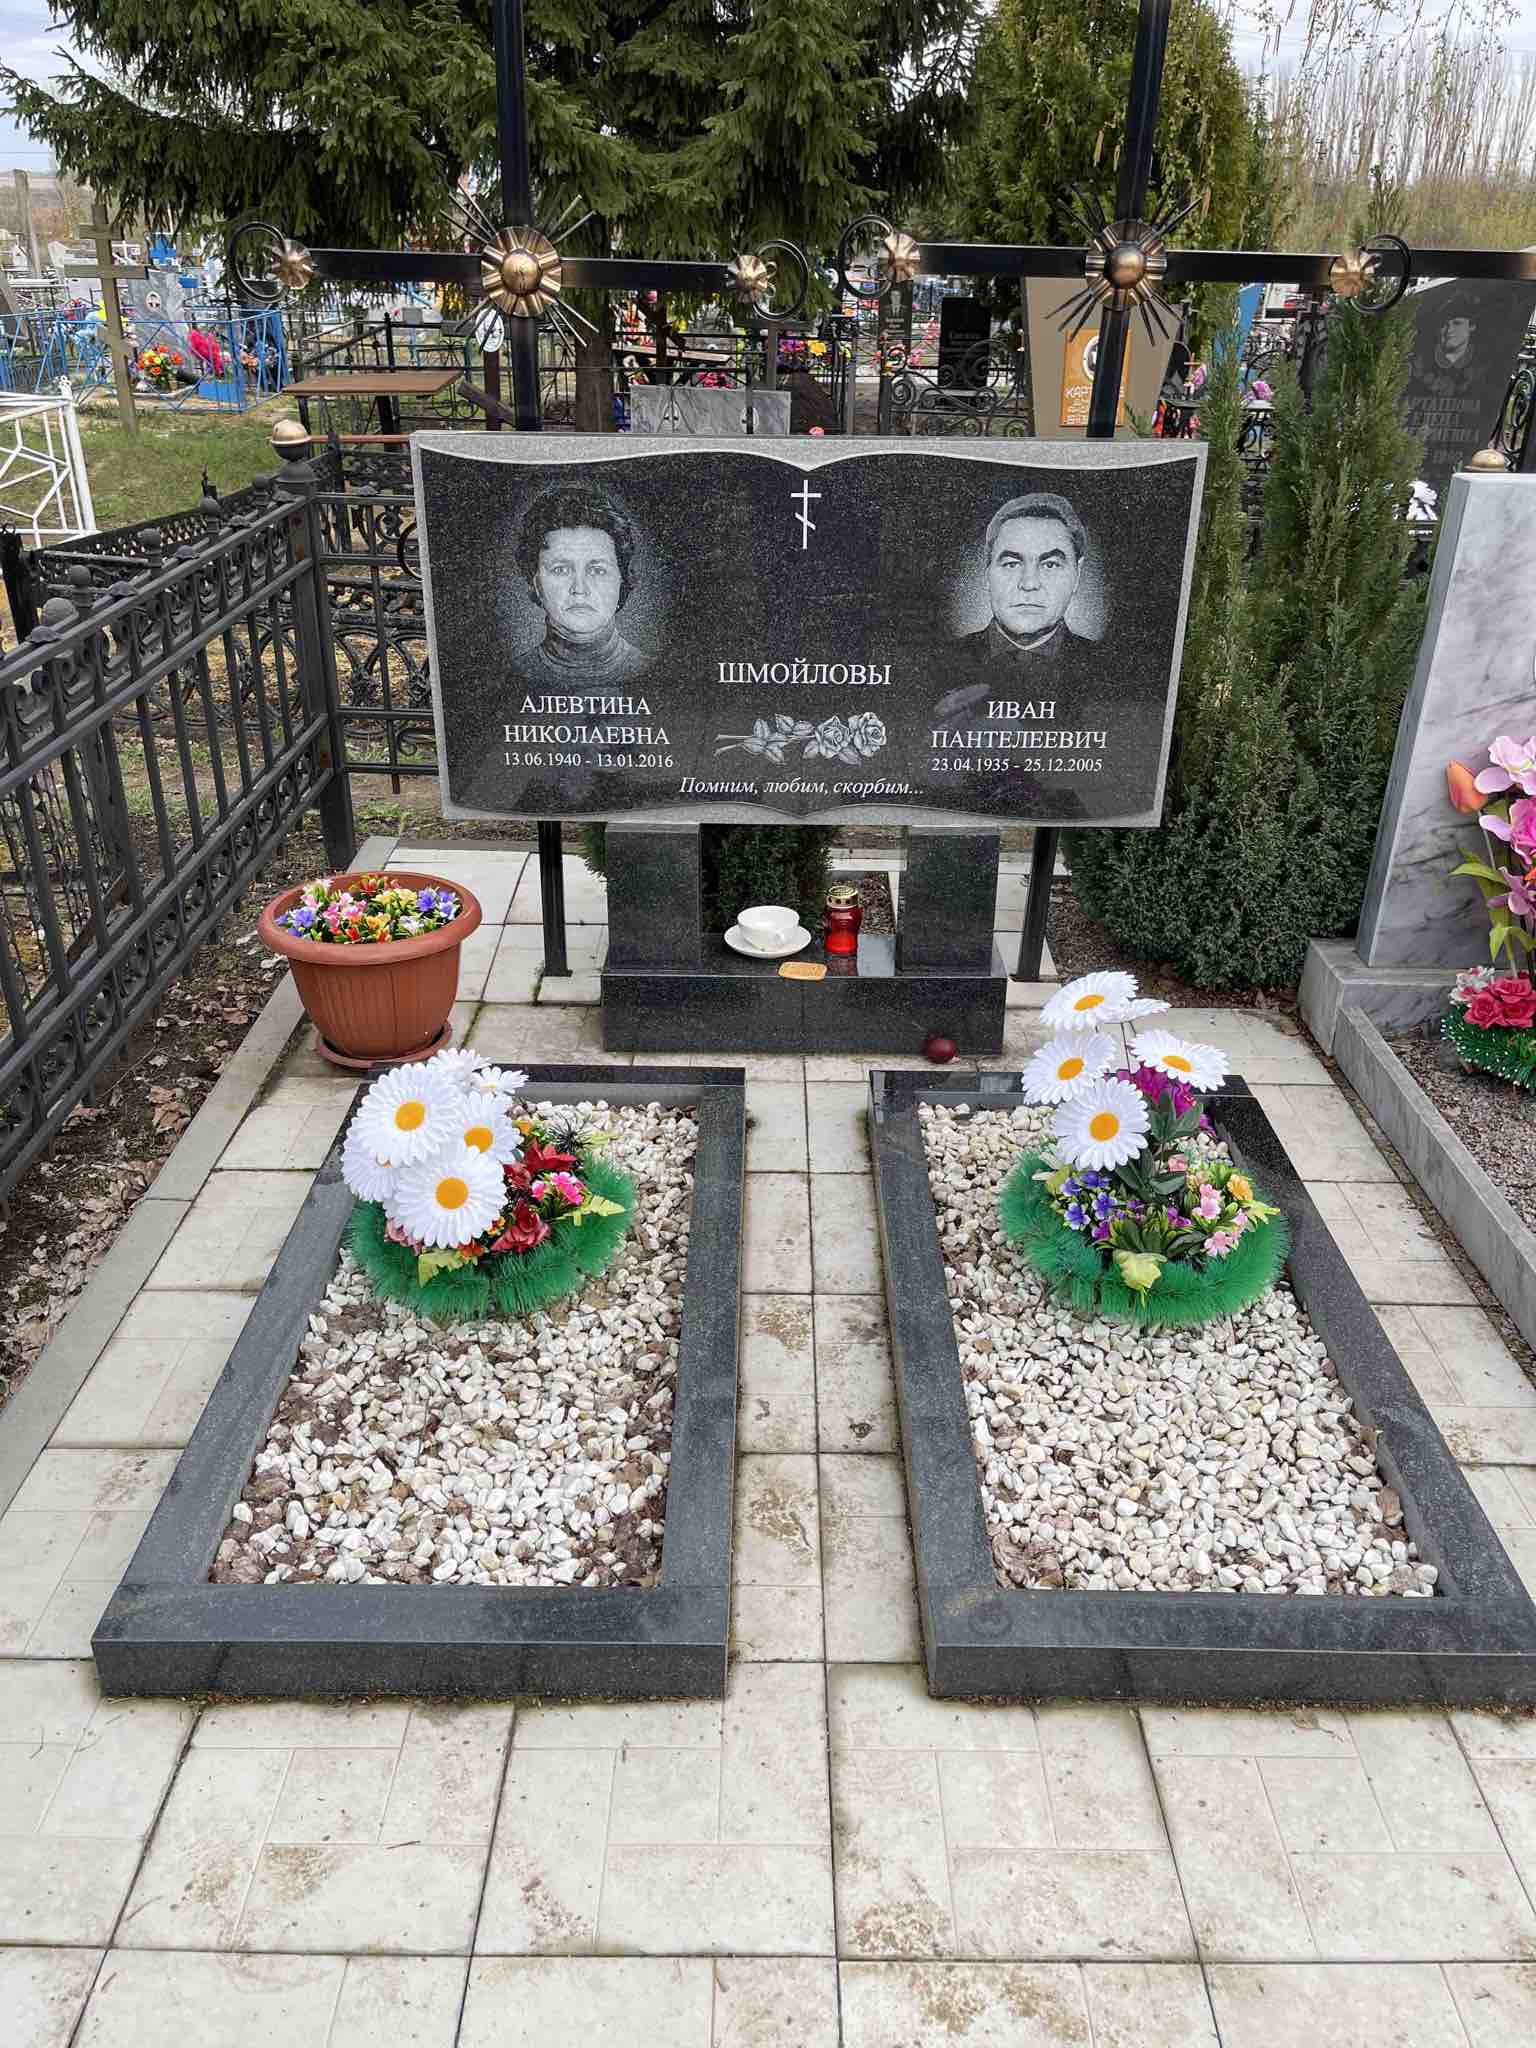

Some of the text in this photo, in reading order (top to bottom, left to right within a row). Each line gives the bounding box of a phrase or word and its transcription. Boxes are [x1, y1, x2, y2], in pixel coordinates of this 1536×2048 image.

[718, 658, 892, 686] ШМОЙЛОВЫ
[520, 696, 652, 715] АЛЕВТИНА
[986, 701, 1057, 719] ИВАН
[503, 725, 671, 745] НИКОЛАЕВНА
[930, 731, 1108, 749] ПАНТЕЛЕЕВИЧ
[504, 753, 581, 768] 13.06.1940
[598, 753, 674, 768] 13.01.2016
[931, 758, 1009, 772] 23.04.1935
[1023, 758, 1103, 772] 25.12.2005
[679, 777, 924, 798] Помним, любим, скорбим...
